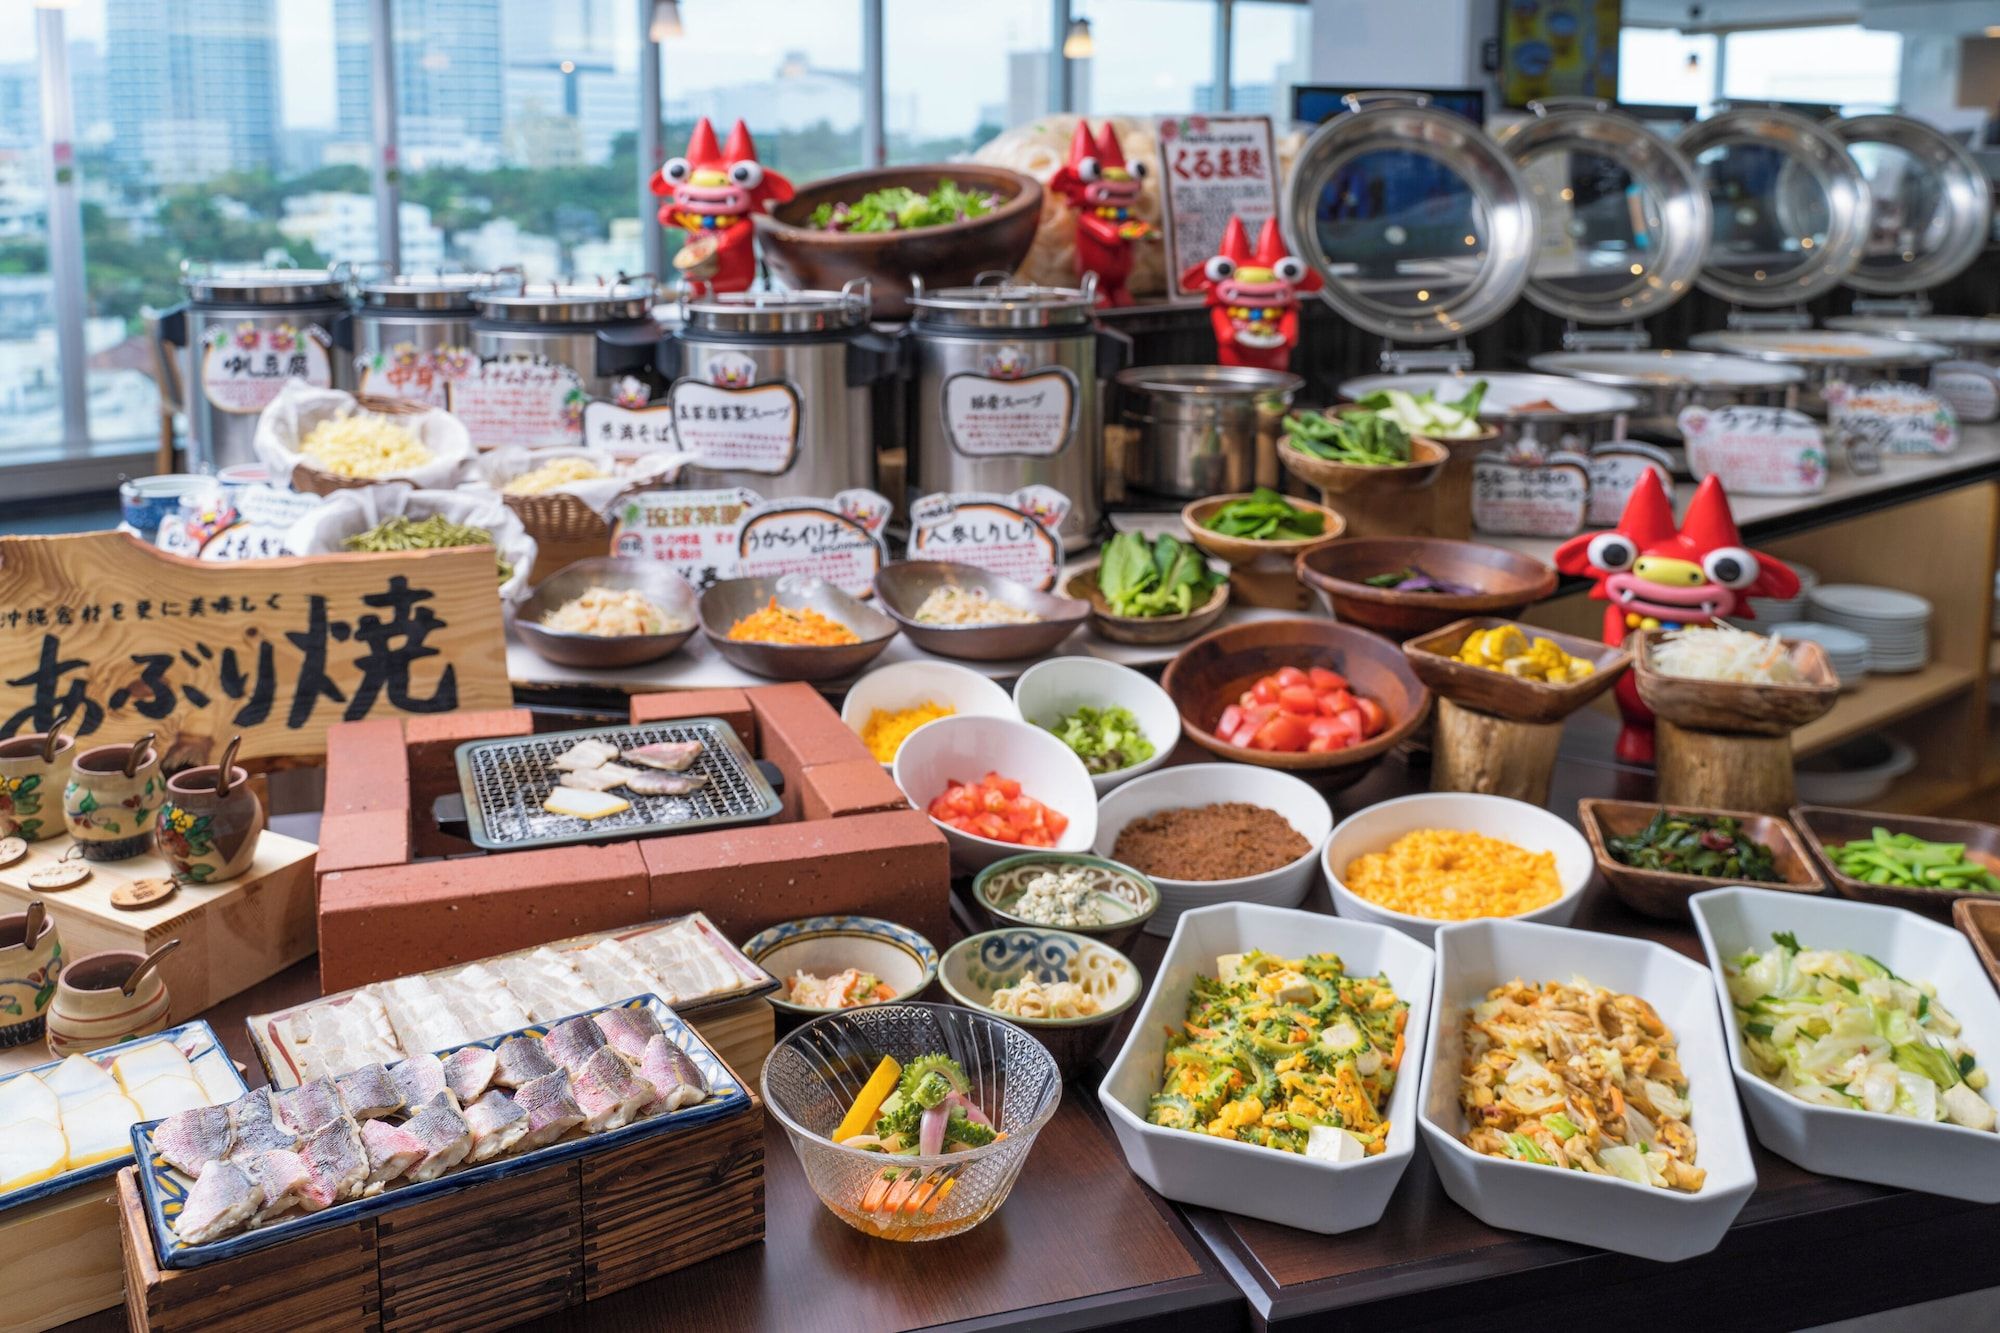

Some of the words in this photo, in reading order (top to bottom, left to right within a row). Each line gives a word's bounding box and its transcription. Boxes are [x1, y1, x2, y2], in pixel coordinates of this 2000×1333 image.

[927, 522, 1035, 544] 人参しりしり
[0, 593, 281, 628] 沖縄食材を更に美味しく
[0, 576, 458, 737] あぶり焼
